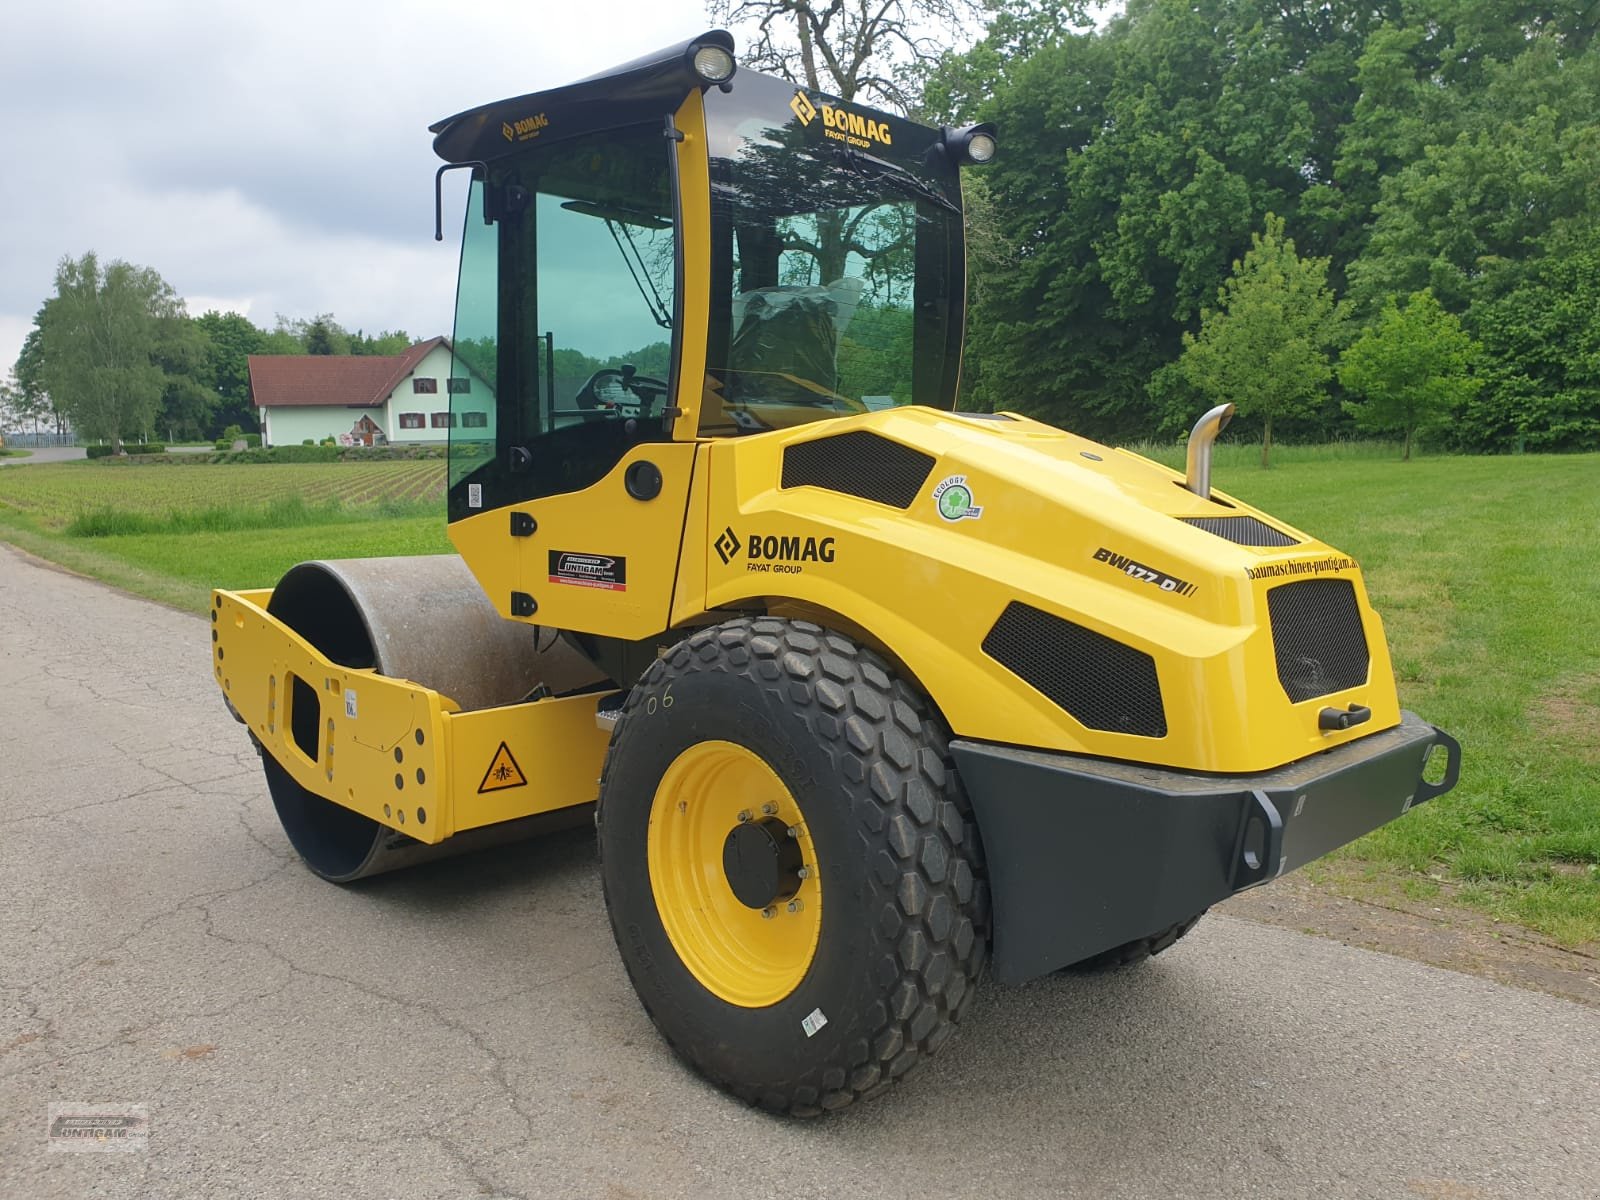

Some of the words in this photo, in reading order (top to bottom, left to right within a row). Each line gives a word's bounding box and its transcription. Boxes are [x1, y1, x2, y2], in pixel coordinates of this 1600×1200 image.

[513, 112, 549, 135] BOMAG
[821, 104, 892, 145] BOMAG
[824, 129, 846, 141] FAYAT
[847, 136, 871, 149] GROUP
[933, 476, 964, 498] ECOLOGY
[748, 535, 835, 563] BOMAG
[747, 563, 771, 573] FAYAT
[773, 564, 802, 575] GROUP
